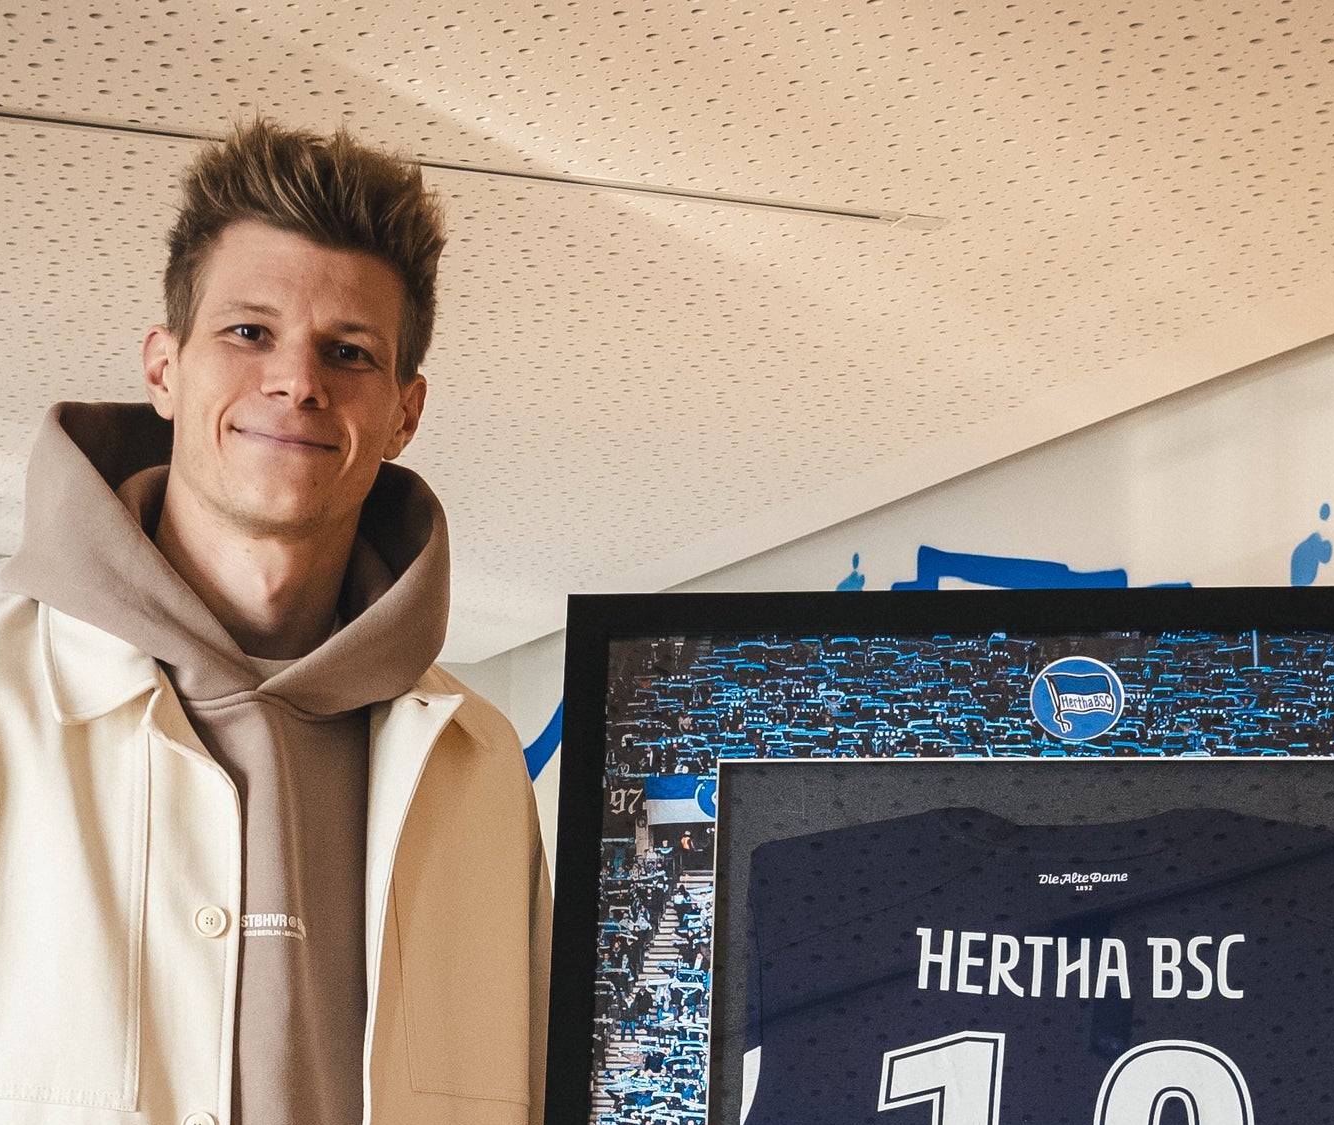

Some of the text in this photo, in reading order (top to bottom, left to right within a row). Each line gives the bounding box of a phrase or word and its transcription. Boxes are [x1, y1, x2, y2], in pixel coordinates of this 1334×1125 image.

[1038, 872, 1128, 885] Die Alte Dame
[916, 928, 1245, 1000] HERTHA BSC
